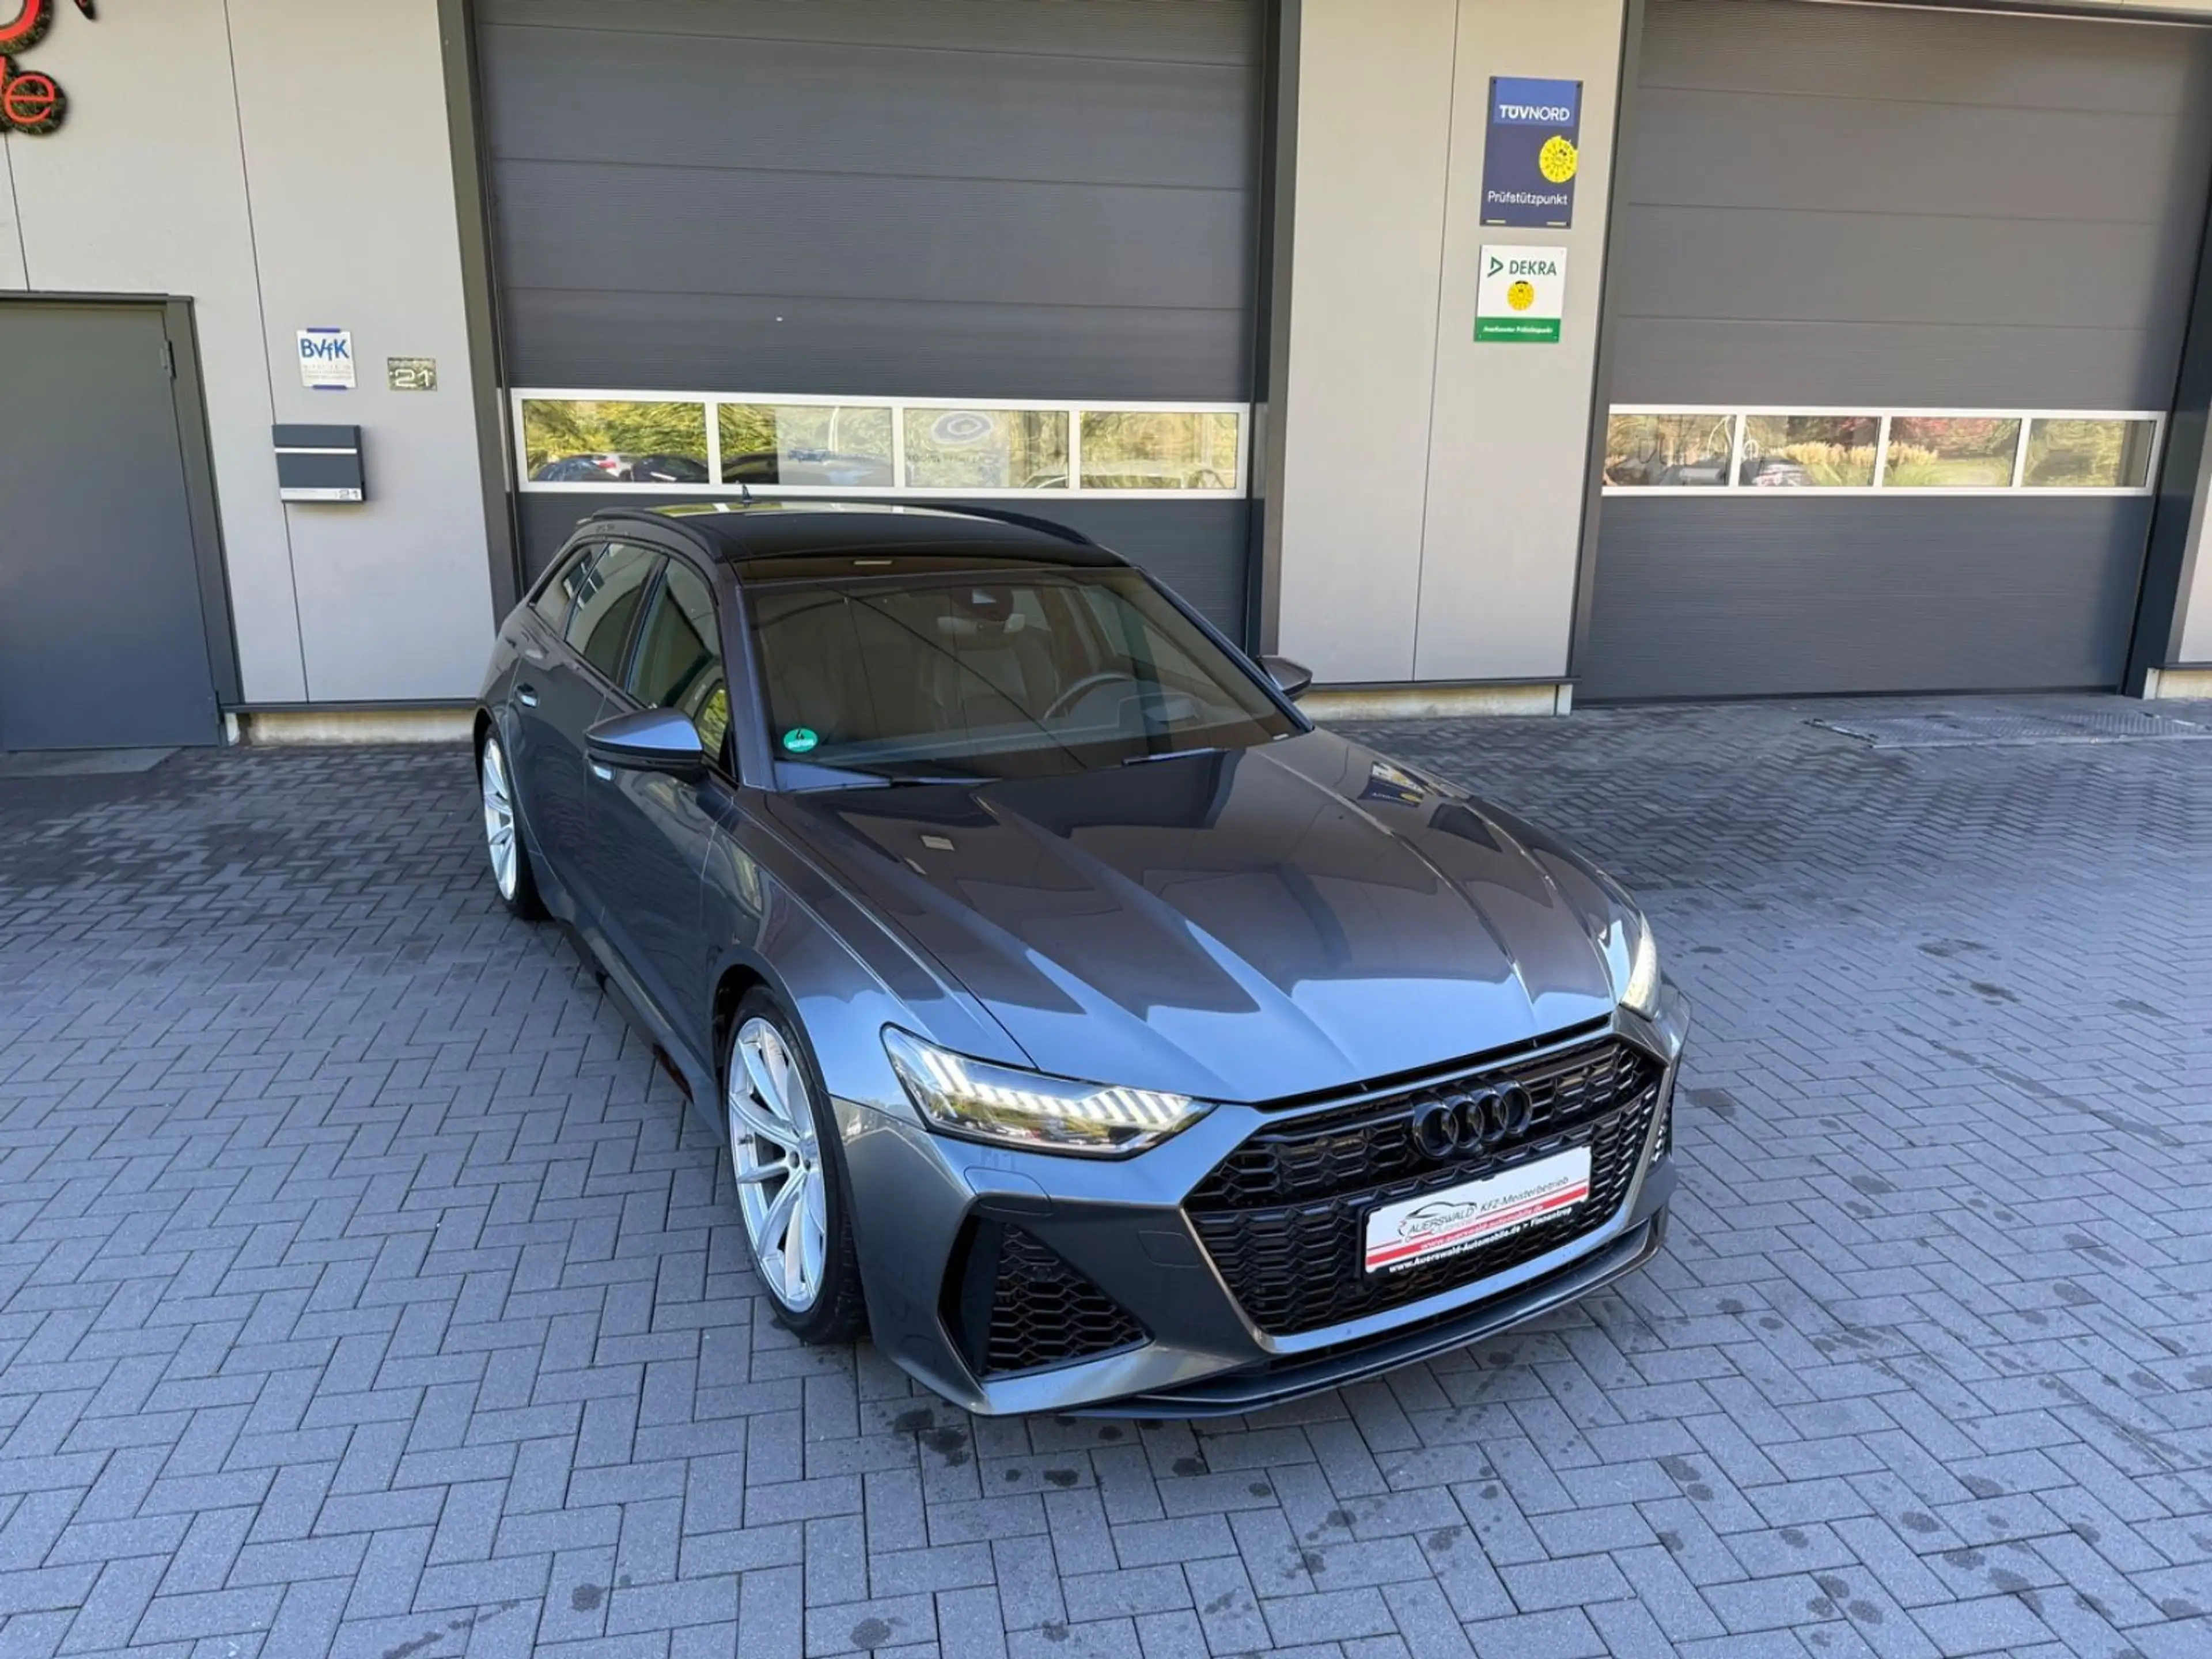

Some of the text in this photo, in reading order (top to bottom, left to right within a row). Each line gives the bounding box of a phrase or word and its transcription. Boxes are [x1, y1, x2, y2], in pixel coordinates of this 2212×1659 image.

[1487, 190, 1568, 207] Prüfstützpunkt
[1509, 260, 1558, 276] DEKRA
[395, 369, 430, 387] 21
[1480, 1176, 1569, 1211] KFZ-Meisterbetrieb
